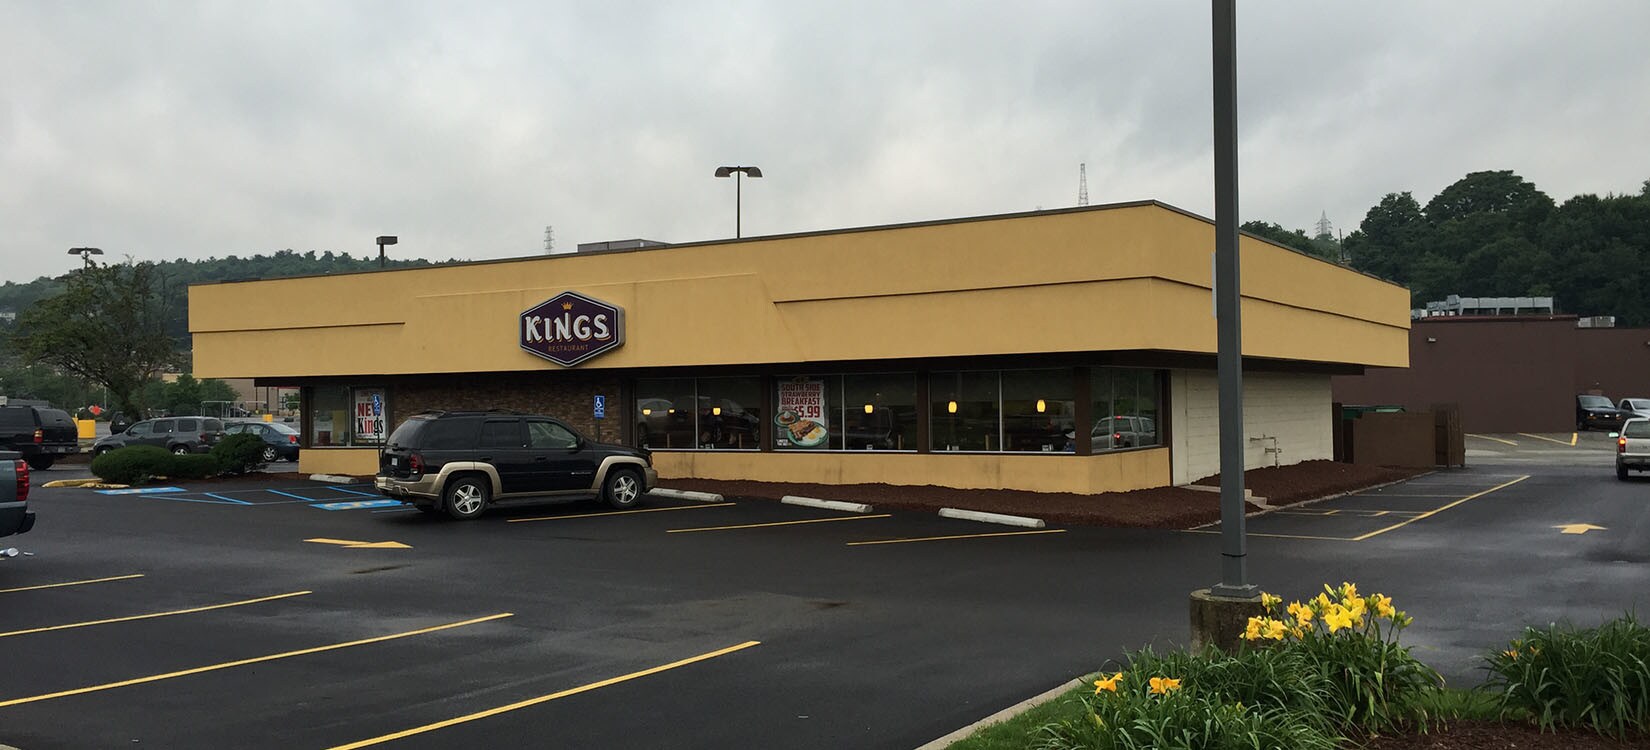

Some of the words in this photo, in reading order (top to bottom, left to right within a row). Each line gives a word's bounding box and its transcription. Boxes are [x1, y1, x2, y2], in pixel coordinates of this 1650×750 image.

[525, 312, 611, 343] KINGS
[548, 344, 589, 352] RESTAURANT
[794, 405, 820, 418] $5.99
[357, 417, 384, 436] Kings
